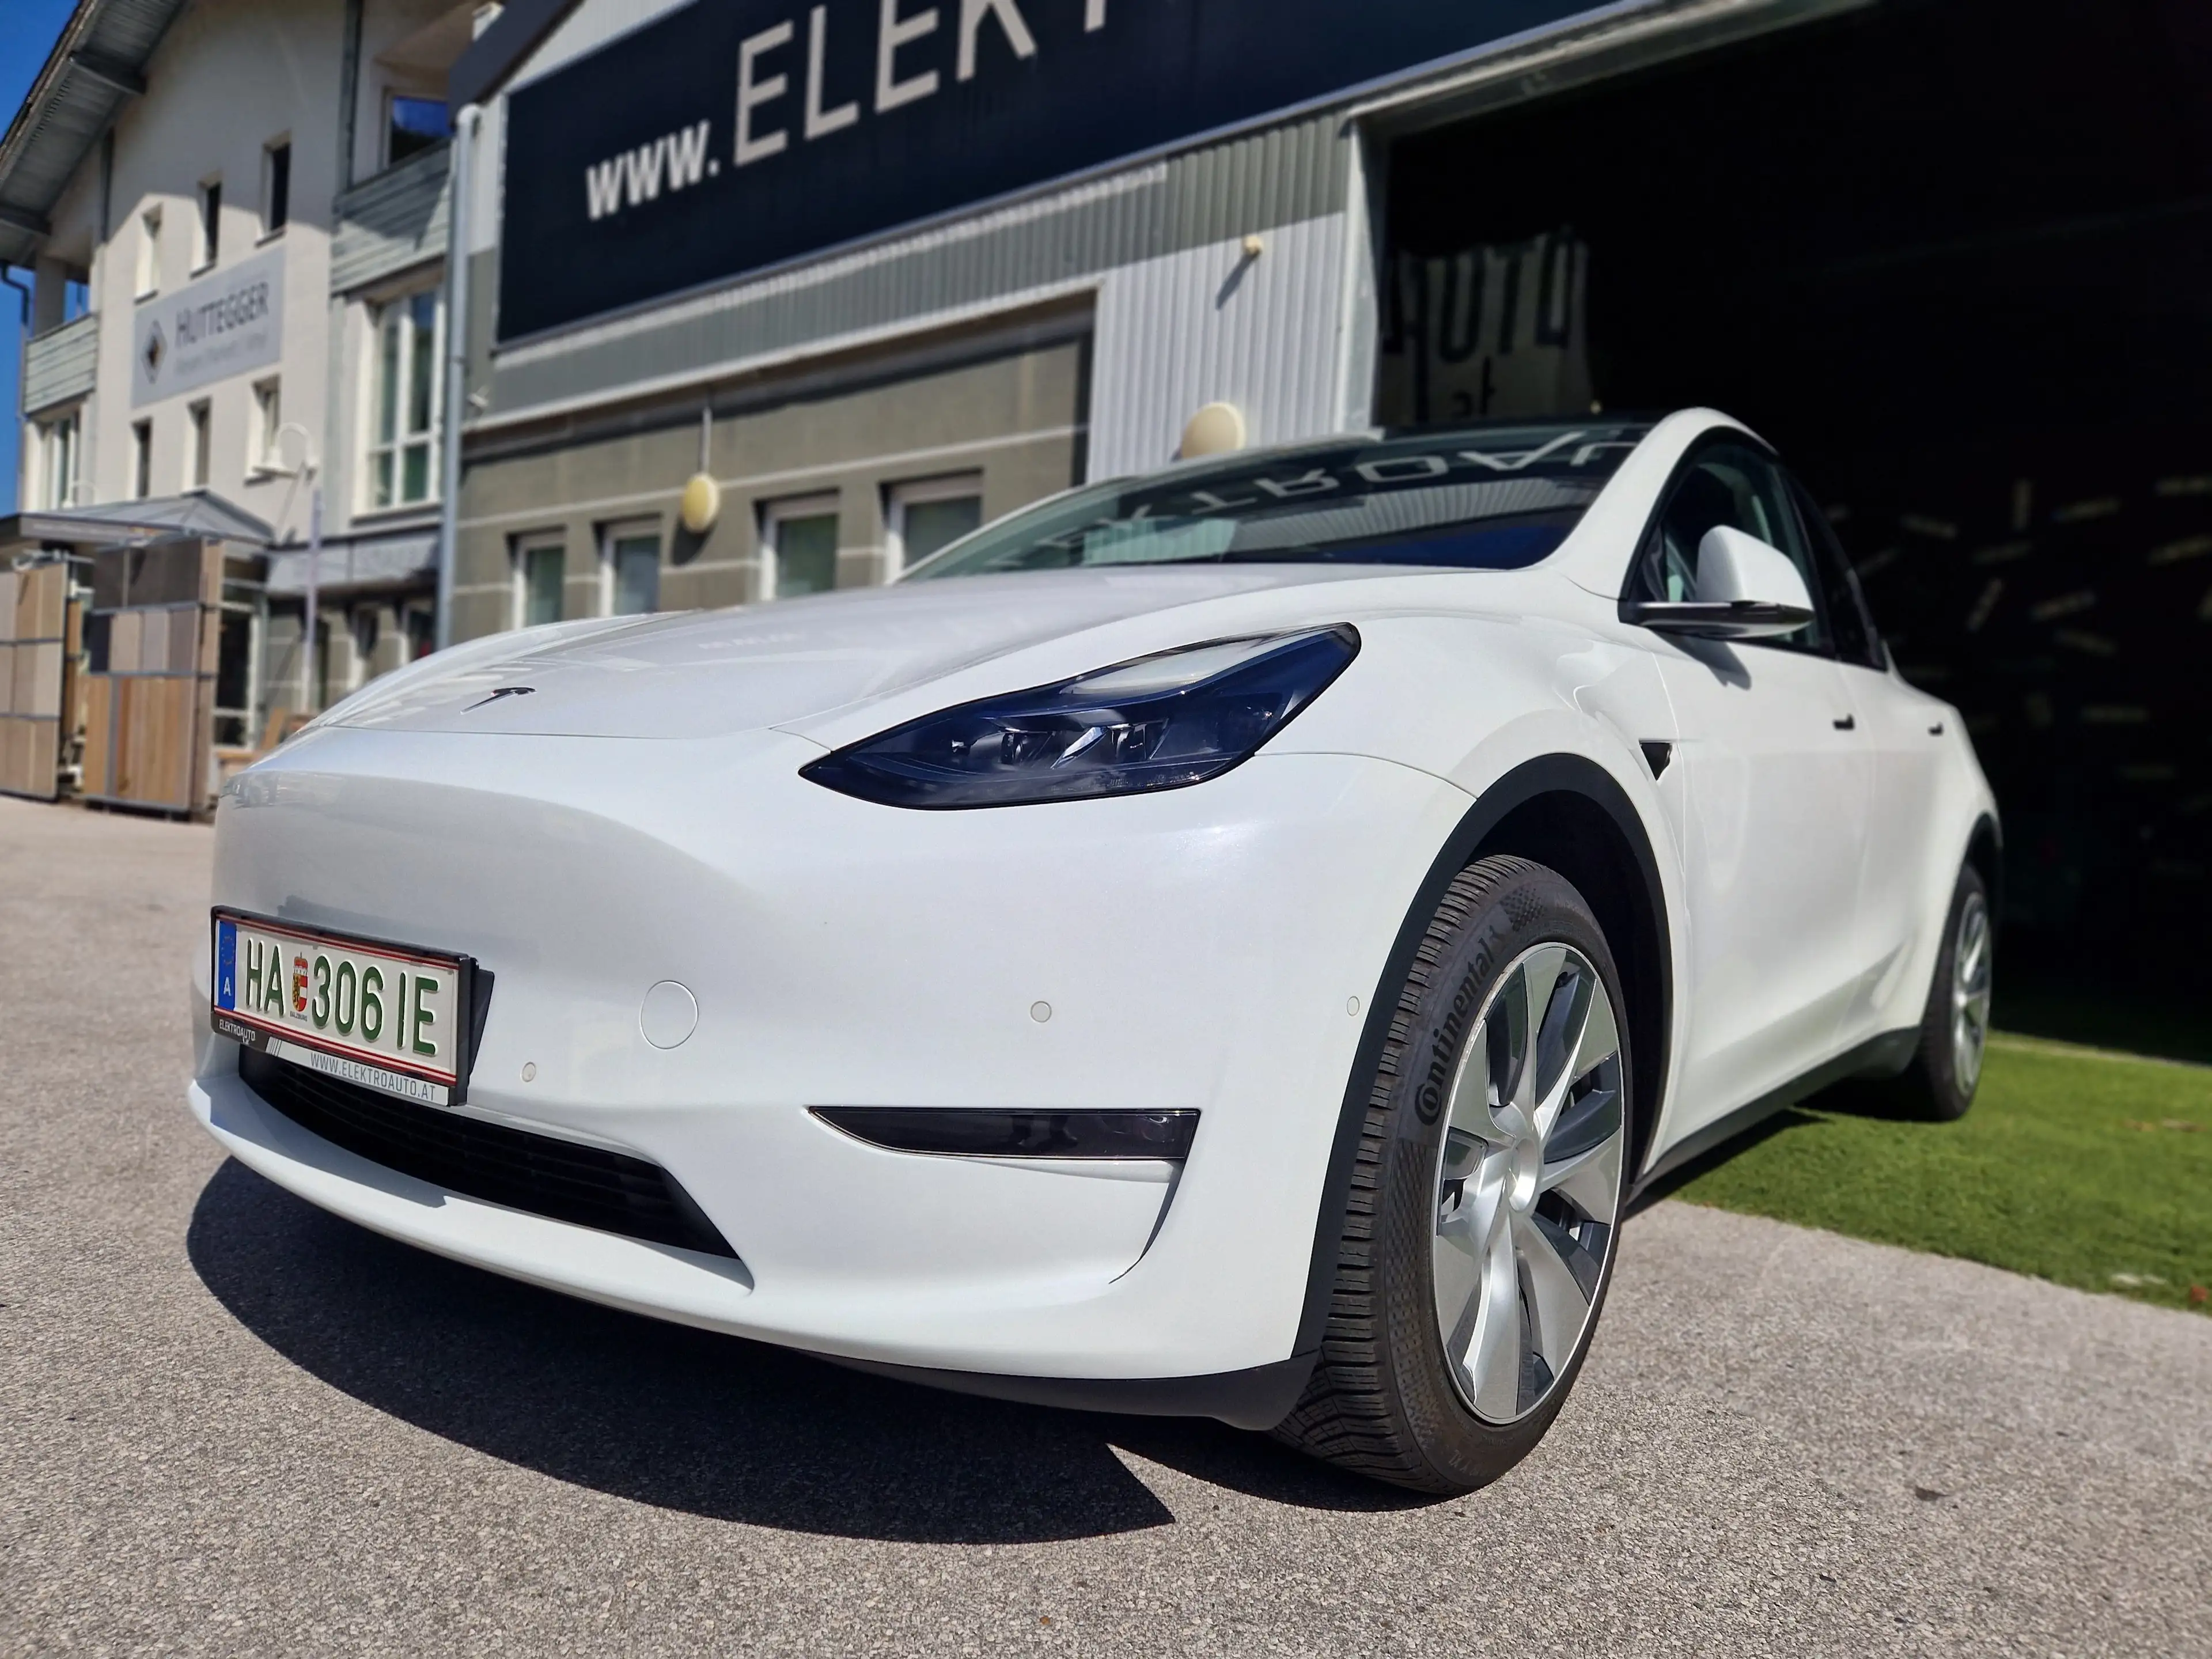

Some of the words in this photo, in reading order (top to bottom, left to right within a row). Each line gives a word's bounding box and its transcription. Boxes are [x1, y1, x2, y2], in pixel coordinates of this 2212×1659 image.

[223, 978, 232, 997] A
[246, 938, 285, 1017] HA
[312, 954, 384, 1043] 306
[397, 971, 440, 1056] IE
[219, 1018, 256, 1041] ELEKTROAUTO
[1415, 937, 1495, 1126] Continental
[310, 1052, 436, 1101] WWW.ELEKTROAUTO.AT
